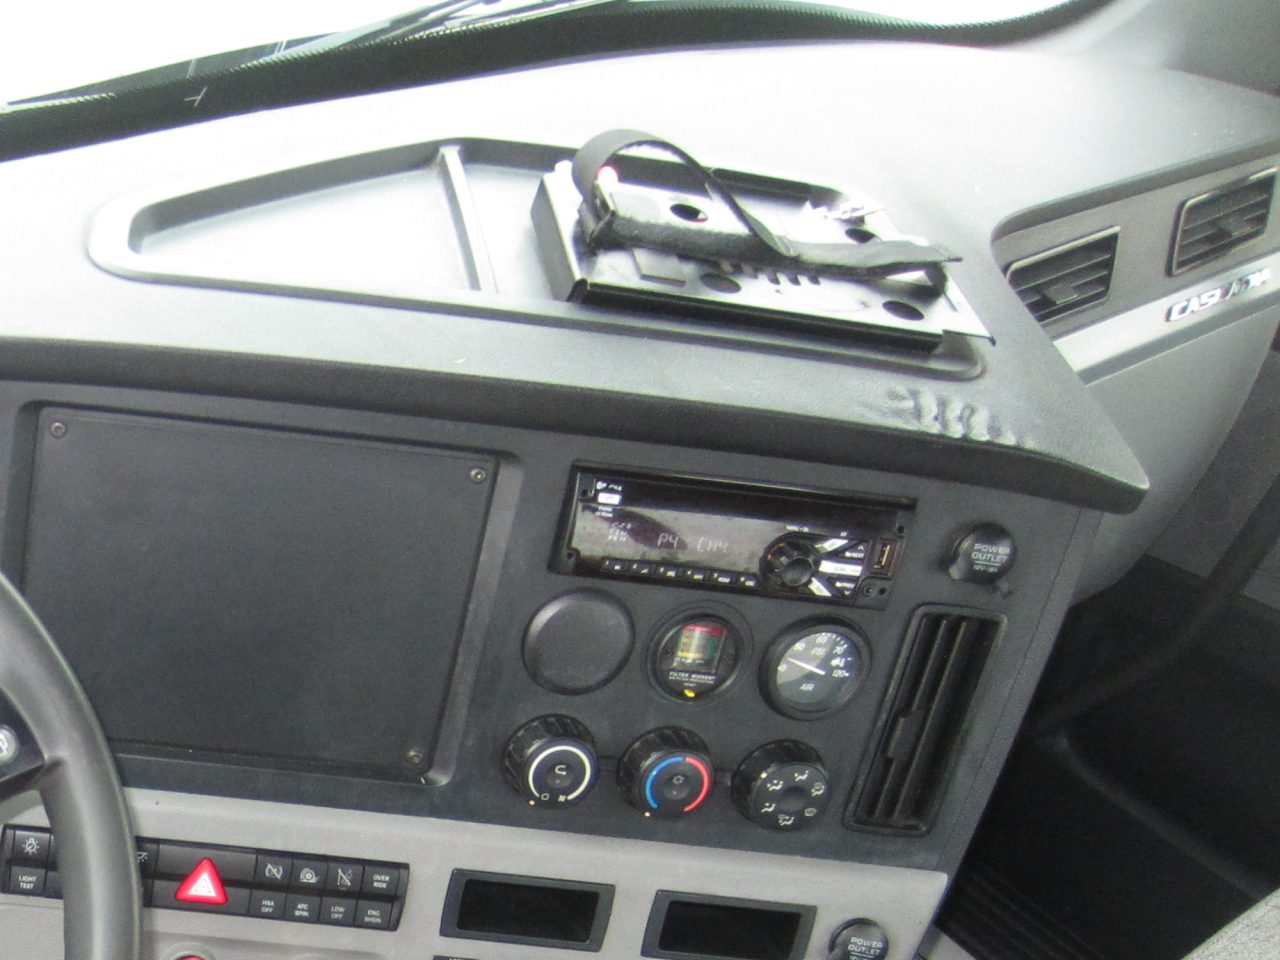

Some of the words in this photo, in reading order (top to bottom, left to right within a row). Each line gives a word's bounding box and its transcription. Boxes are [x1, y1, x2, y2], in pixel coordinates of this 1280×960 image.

[974, 543, 1011, 555] POWER
[971, 551, 1008, 563] OUTLET
[800, 683, 815, 691] AIR
[19, 874, 37, 883] LIGHT
[373, 874, 390, 882] OVER
[20, 882, 35, 890] TEST
[367, 909, 381, 917] ENG
[850, 936, 883, 949] POWER
[848, 944, 880, 956] OUTLET
